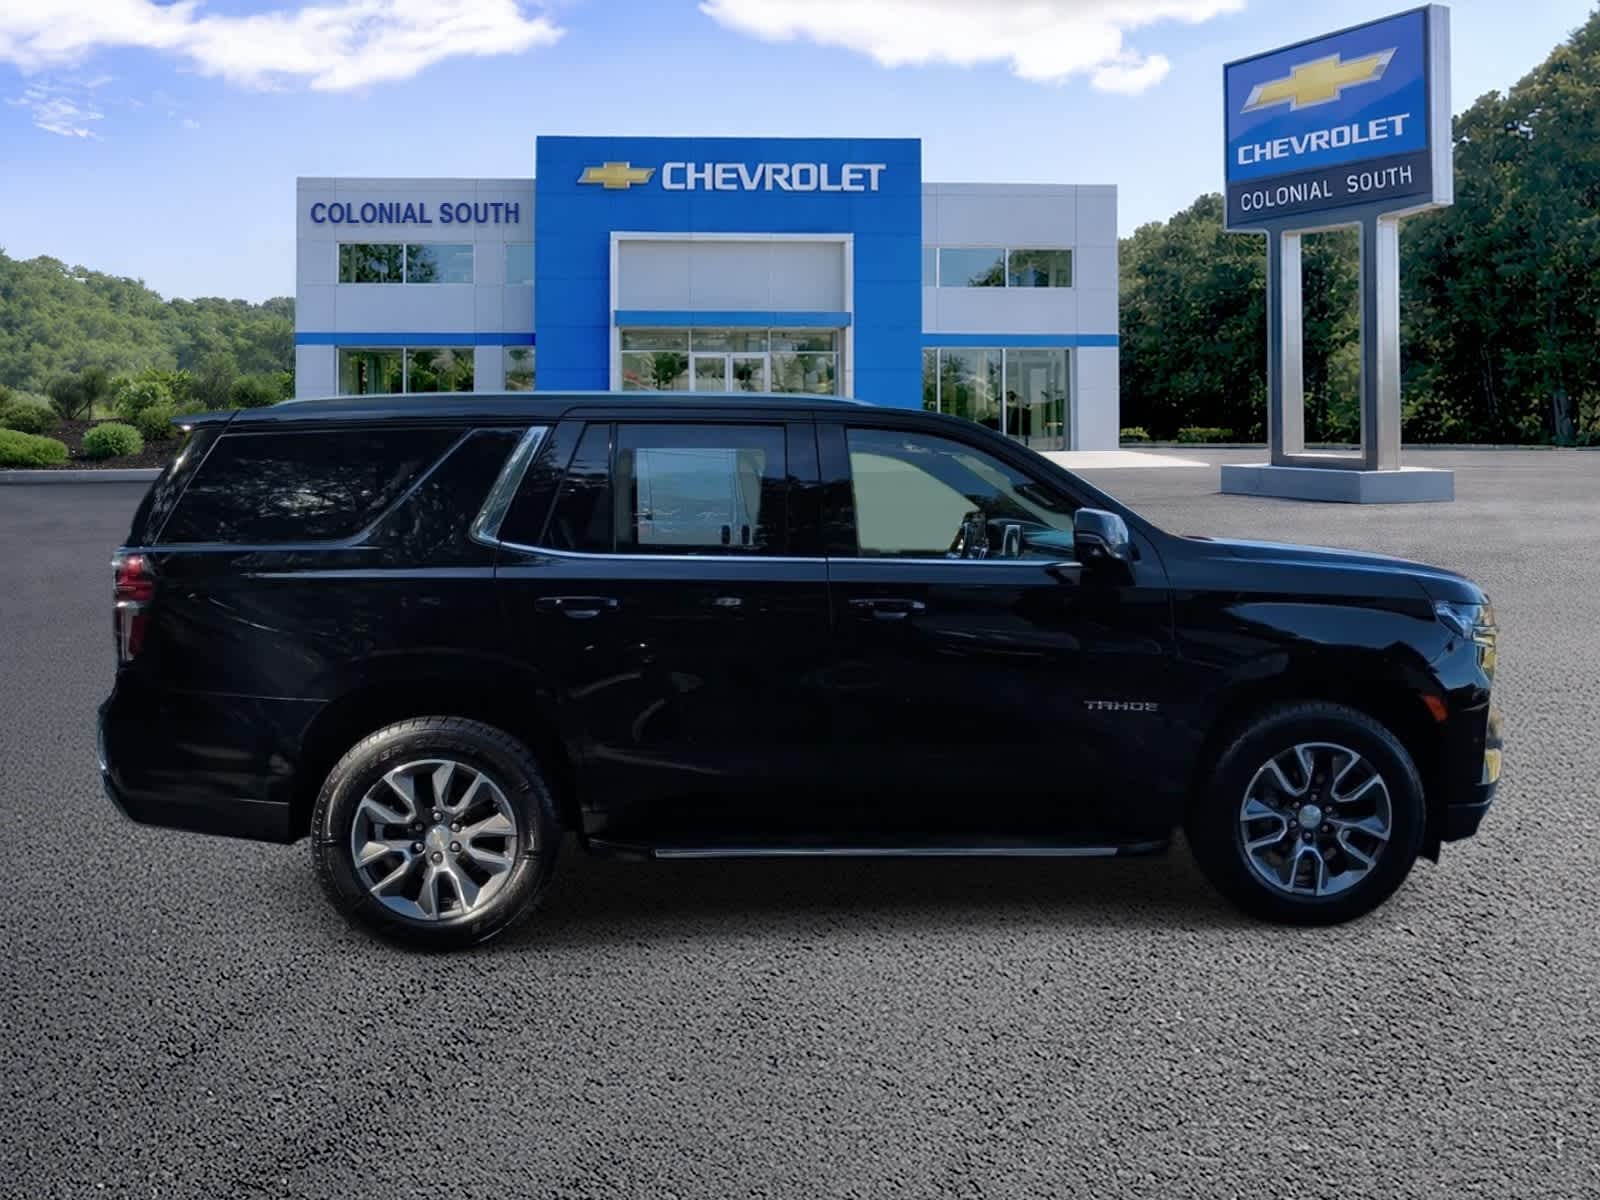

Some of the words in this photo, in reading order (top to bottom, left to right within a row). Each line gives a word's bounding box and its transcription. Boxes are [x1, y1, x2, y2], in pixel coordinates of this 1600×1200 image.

[1237, 113, 1410, 165] CHEVROLET
[661, 162, 887, 191] CHEVROLET
[1241, 179, 1333, 212] COLONIAL
[1346, 165, 1413, 194] SOUTH
[310, 202, 432, 224] COLONIAL
[439, 202, 520, 224] SOUTH
[1083, 700, 1160, 712] TAHOE
